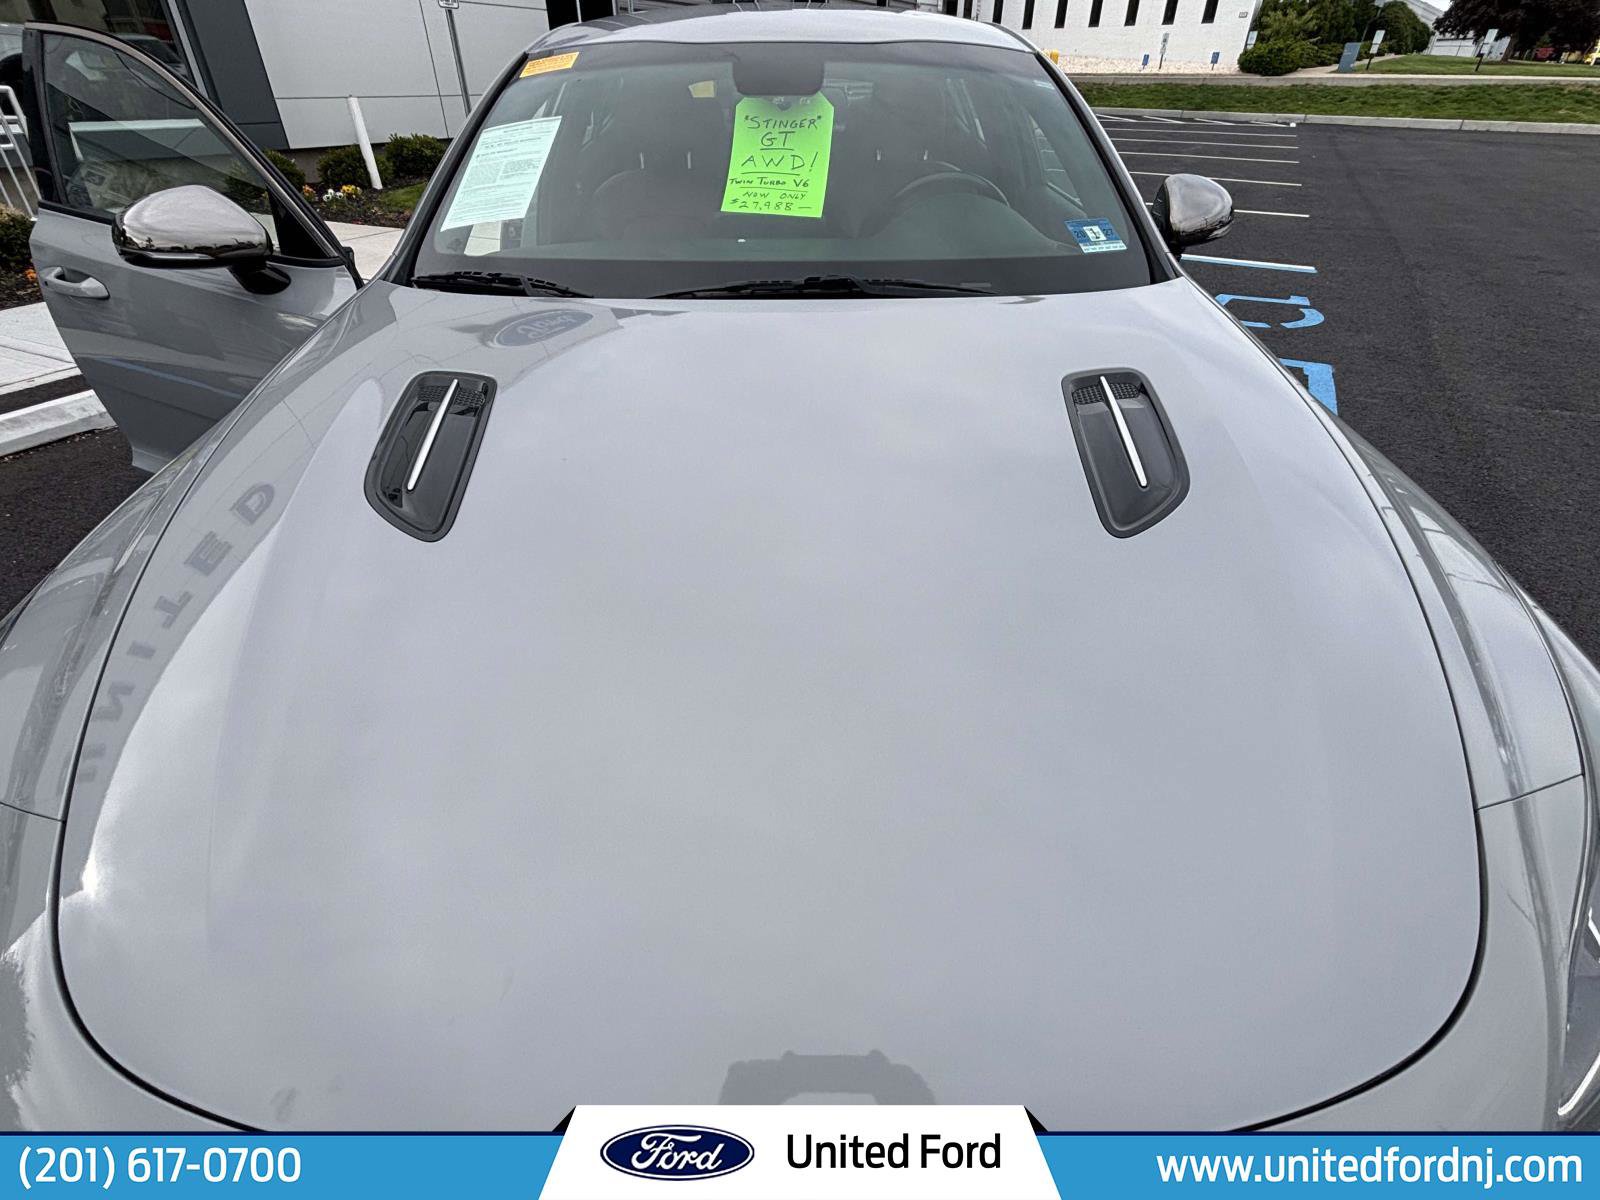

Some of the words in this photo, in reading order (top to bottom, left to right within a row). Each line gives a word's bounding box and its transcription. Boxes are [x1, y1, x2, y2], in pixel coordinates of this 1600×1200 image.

[760, 130, 796, 148] GT
[741, 151, 819, 173] AWD!
[793, 178, 810, 188] V6
[742, 191, 770, 199] NOW
[779, 192, 808, 200] ONLY
